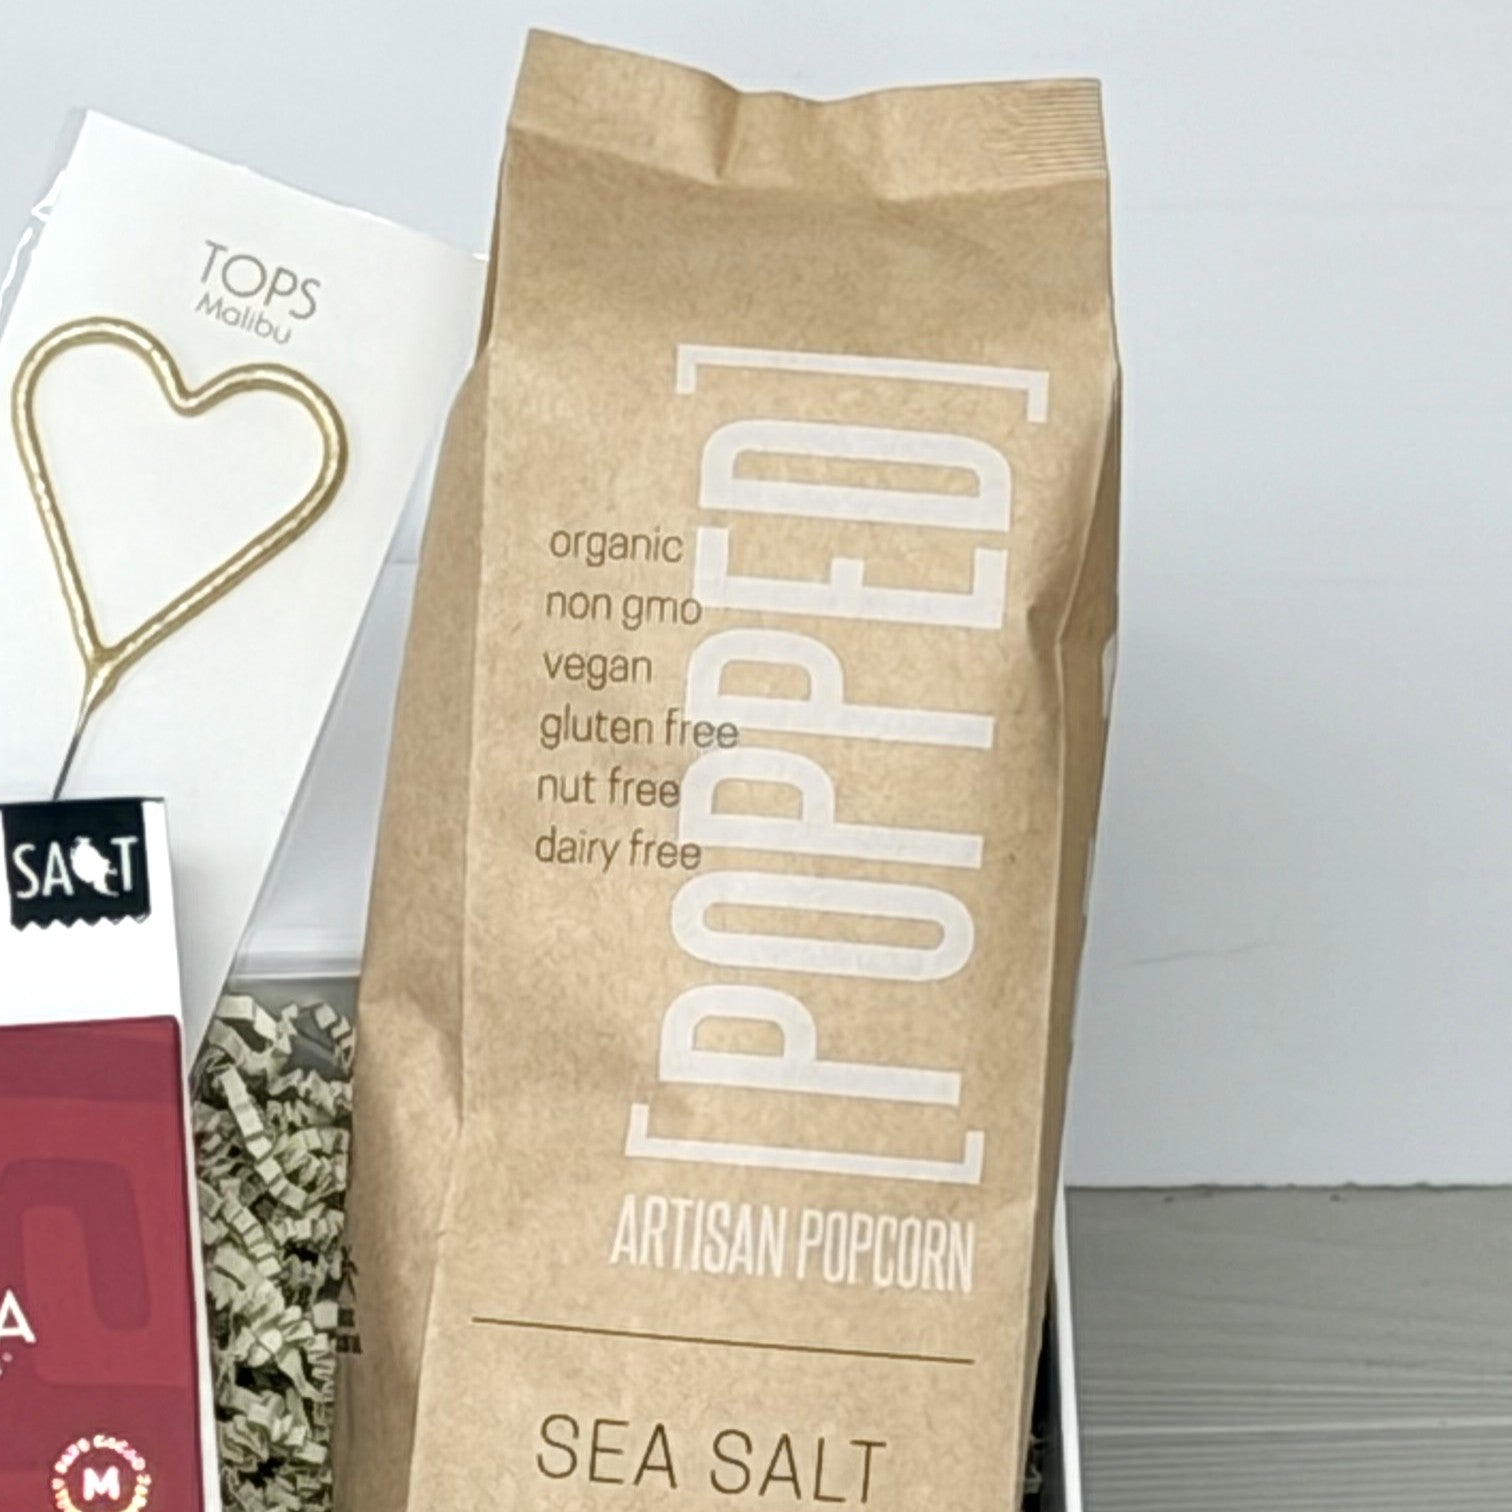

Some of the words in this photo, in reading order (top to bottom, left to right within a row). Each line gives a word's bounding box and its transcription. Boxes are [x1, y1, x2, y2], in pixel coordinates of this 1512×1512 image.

[193, 240, 323, 322] TOPS
[193, 290, 292, 345] Malibu
[550, 527, 683, 567] organic
[545, 590, 611, 620] non
[623, 595, 702, 630] gmo
[543, 651, 652, 691] vegan
[540, 704, 652, 749] gluten
[665, 707, 739, 748] free
[537, 771, 595, 804] nut
[609, 766, 680, 808] free
[535, 826, 619, 873] dairy
[630, 829, 701, 870] free
[610, 1194, 787, 1279] ARTISAN
[796, 1207, 976, 1294] POPCORN
[536, 1414, 677, 1491] SEA
[710, 1429, 887, 1503] SALT
[83, 1466, 120, 1501] M
